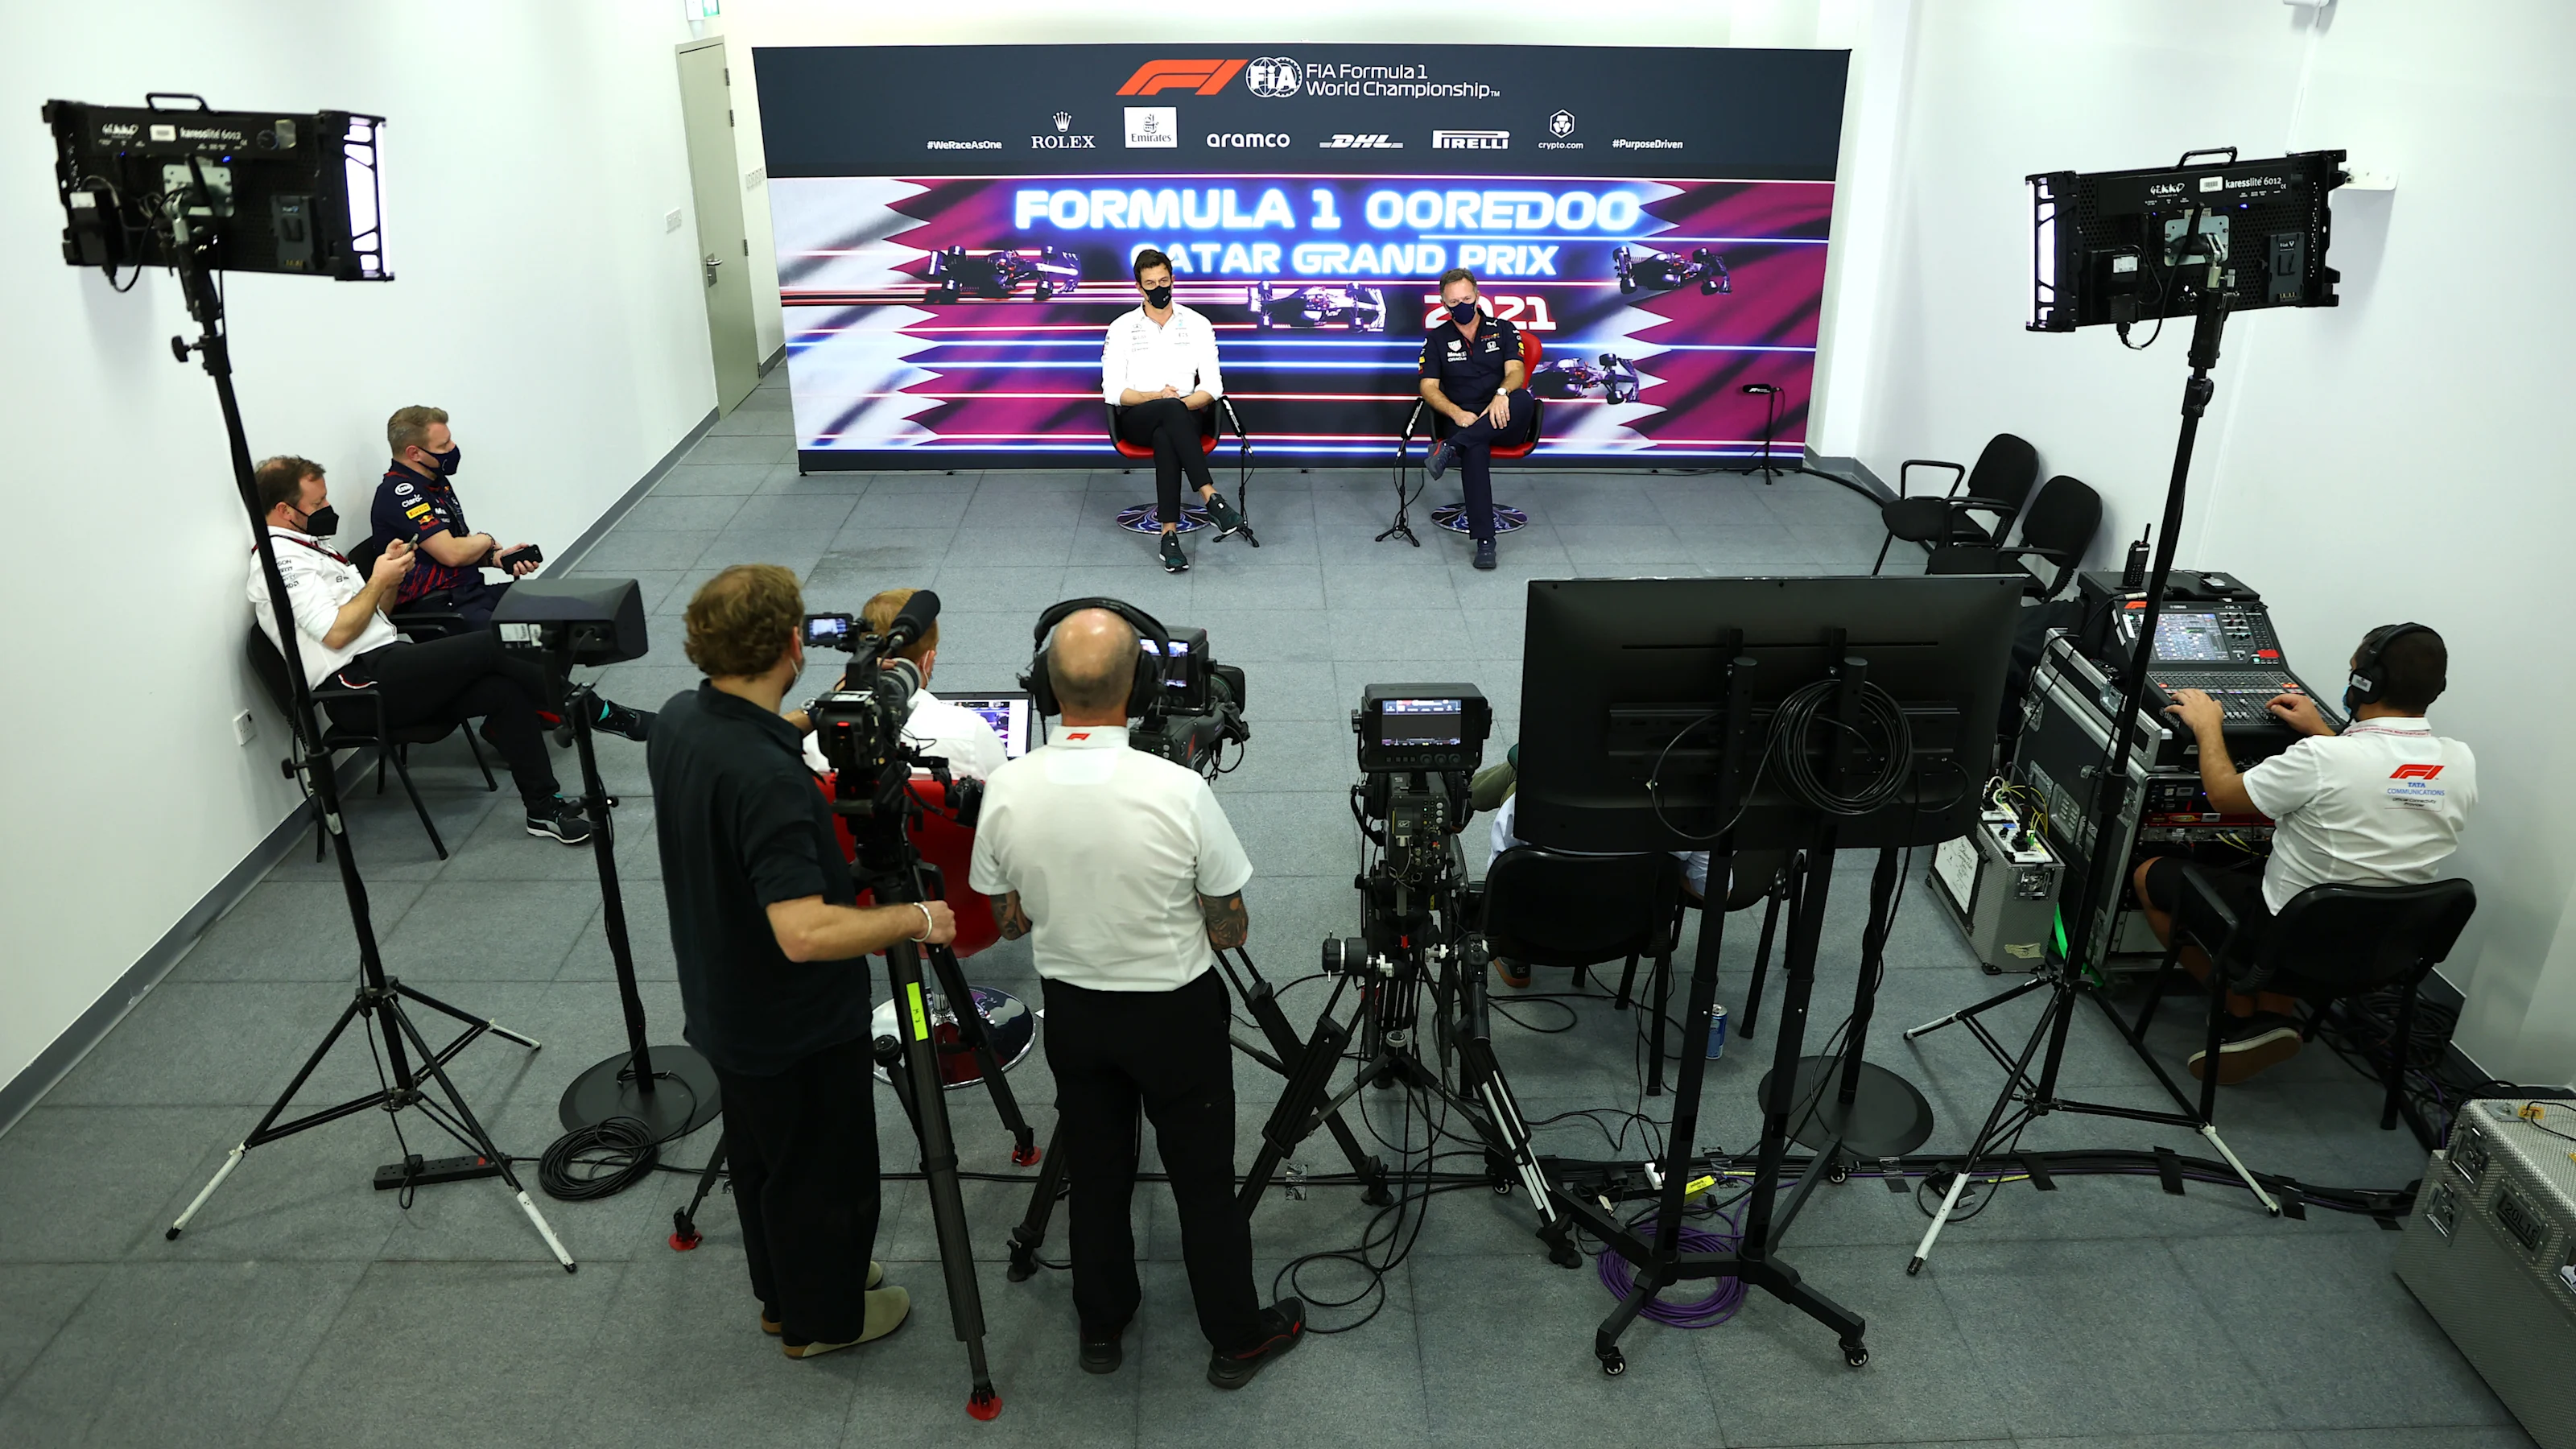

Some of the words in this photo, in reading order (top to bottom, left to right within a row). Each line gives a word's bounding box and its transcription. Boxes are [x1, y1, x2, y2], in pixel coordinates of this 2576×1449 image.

[1116, 59, 1249, 95] F1
[1306, 64, 1335, 79] FIA
[1340, 63, 1412, 79] Formula
[1418, 64, 1427, 79] 1
[1306, 81, 1360, 97] World
[927, 140, 1002, 150] #WeRaceAsOne
[1031, 135, 1096, 149] ROLEX
[1131, 133, 1171, 143] Emirates
[1206, 132, 1290, 149] aramco
[1332, 134, 1393, 148] DHL
[1432, 130, 1510, 149] PIRELLI
[1538, 140, 1583, 150] crypto.com
[1612, 139, 1683, 150] #PurposeDriven
[2225, 176, 2262, 188] karesslite
[2264, 177, 2281, 185] 6012
[1014, 188, 1294, 229] FORMULA
[1311, 188, 1341, 229] 1
[1366, 190, 1640, 230] OOREDOO
[1293, 244, 1446, 274] GRAND
[1459, 246, 1559, 275] PRIX
[2389, 764, 2445, 780] F1
[2387, 788, 2445, 796] COMMUNICATIONS
